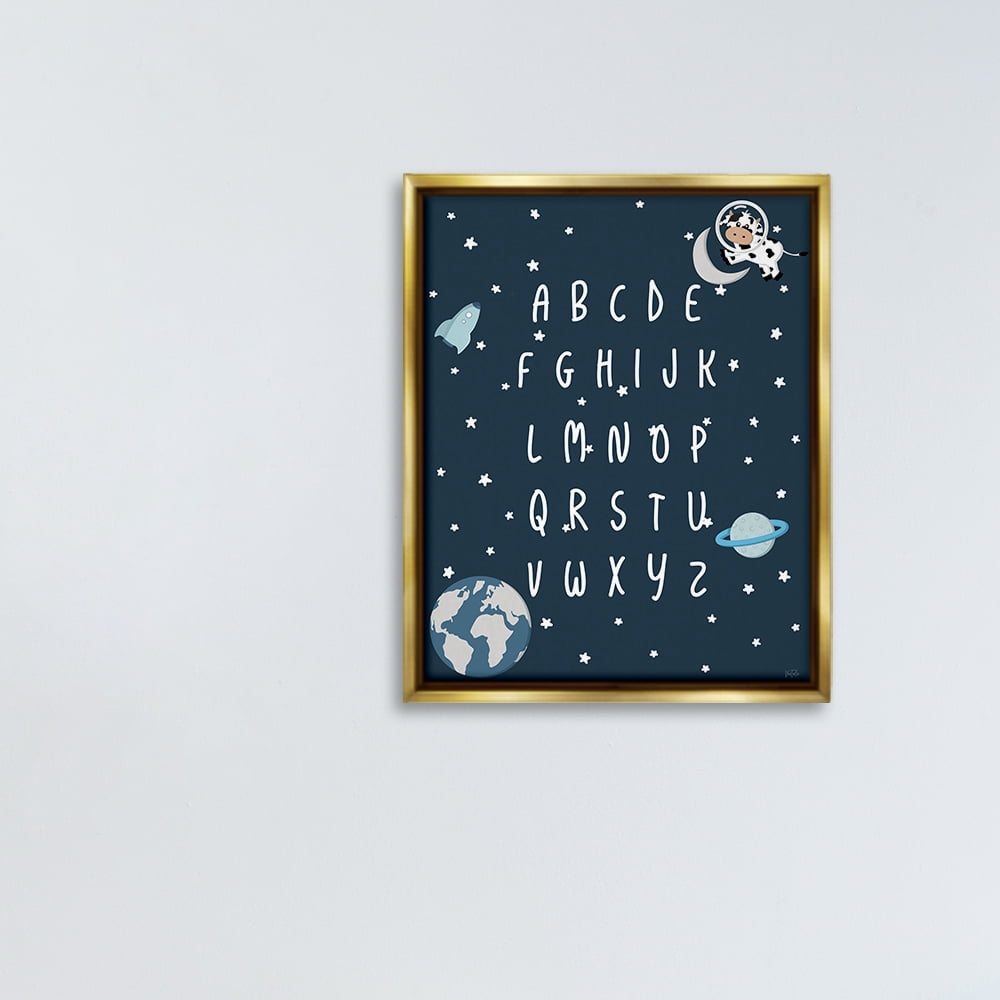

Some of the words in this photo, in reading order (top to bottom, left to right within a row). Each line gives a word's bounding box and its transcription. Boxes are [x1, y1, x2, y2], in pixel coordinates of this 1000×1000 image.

[532, 283, 550, 323] A
[571, 279, 588, 322] B
[609, 284, 627, 323] C
[647, 279, 664, 322] D
[684, 283, 702, 322] E
[517, 351, 534, 389] F
[555, 350, 575, 389] G
[596, 348, 614, 389] H
[662, 347, 678, 389] J
[698, 348, 717, 389] K
[527, 424, 543, 464] L
[564, 419, 587, 464] M
[607, 421, 630, 464] N
[650, 423, 670, 464] O
[690, 424, 708, 464] P
[529, 488, 549, 538] Q
[568, 487, 589, 532] R
[610, 490, 628, 532] S
[648, 492, 666, 532] T
[687, 490, 707, 532] U
[527, 559, 543, 598] V
[564, 560, 587, 598] W
[608, 555, 626, 598] X
[647, 552, 668, 602] Y
